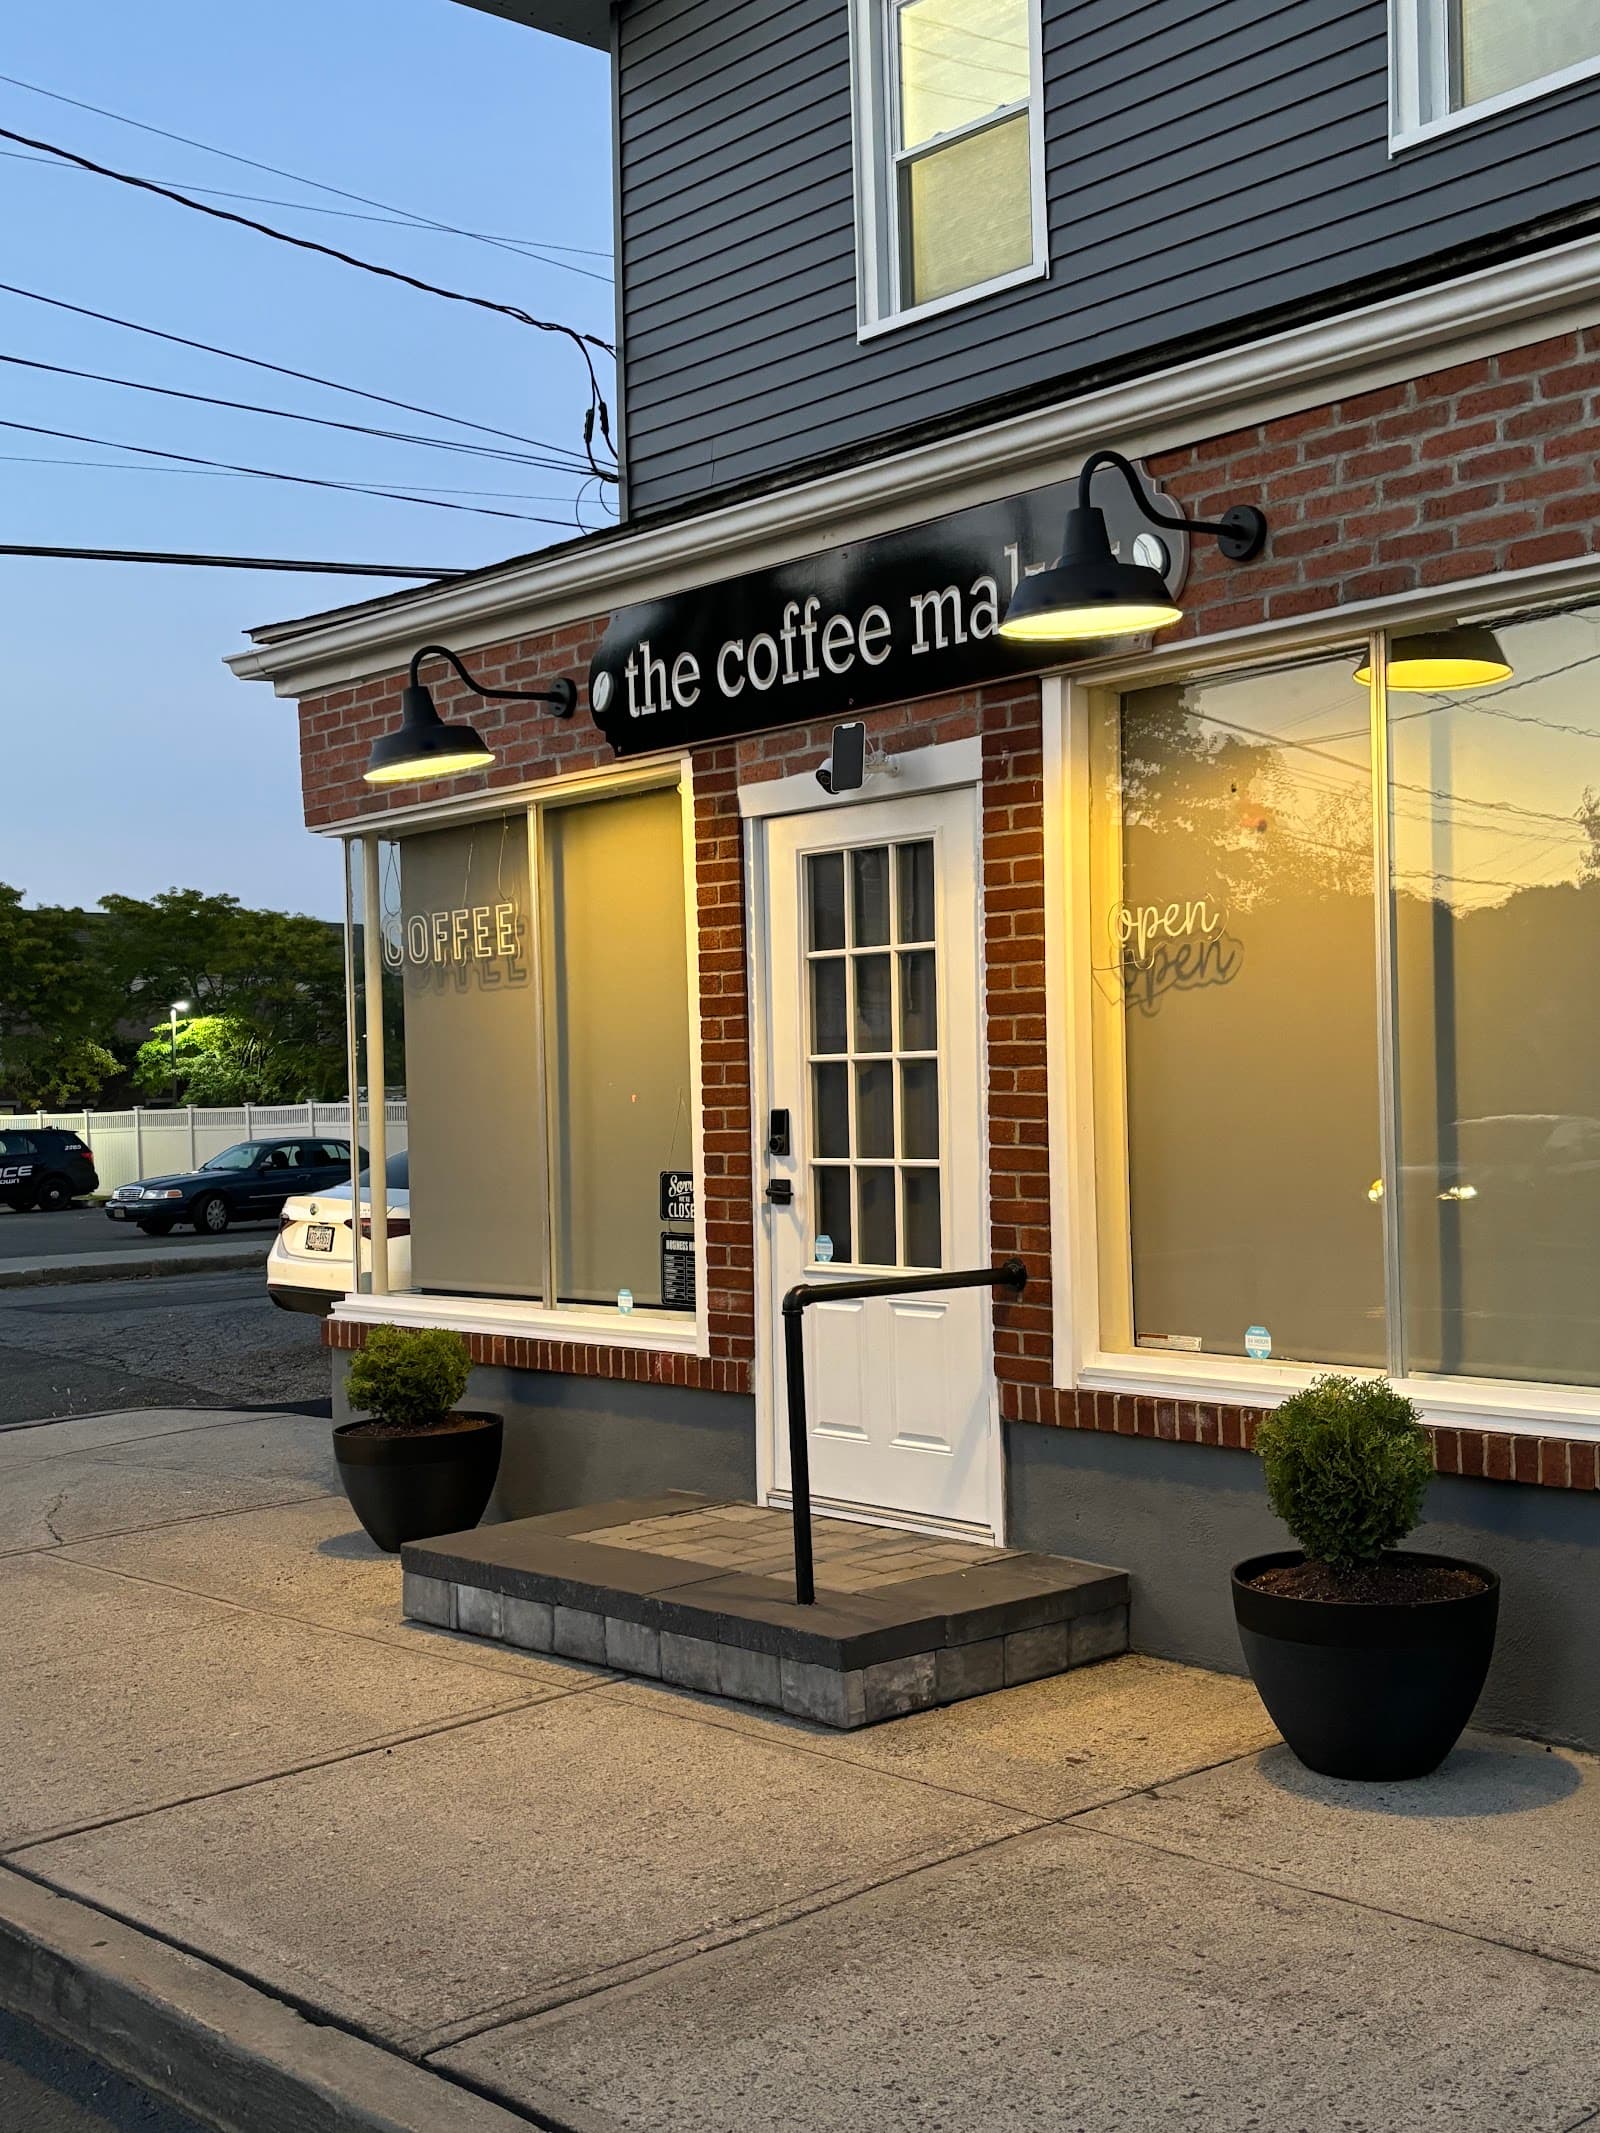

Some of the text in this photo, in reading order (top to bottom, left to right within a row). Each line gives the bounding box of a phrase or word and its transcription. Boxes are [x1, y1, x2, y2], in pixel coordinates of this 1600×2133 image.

[625, 640, 700, 718] the
[717, 597, 892, 697] coffee
[384, 903, 515, 966] COFFEE
[1116, 901, 1220, 960] open
[668, 1175, 693, 1197] Sorr
[668, 1202, 695, 1219] CLOSE
